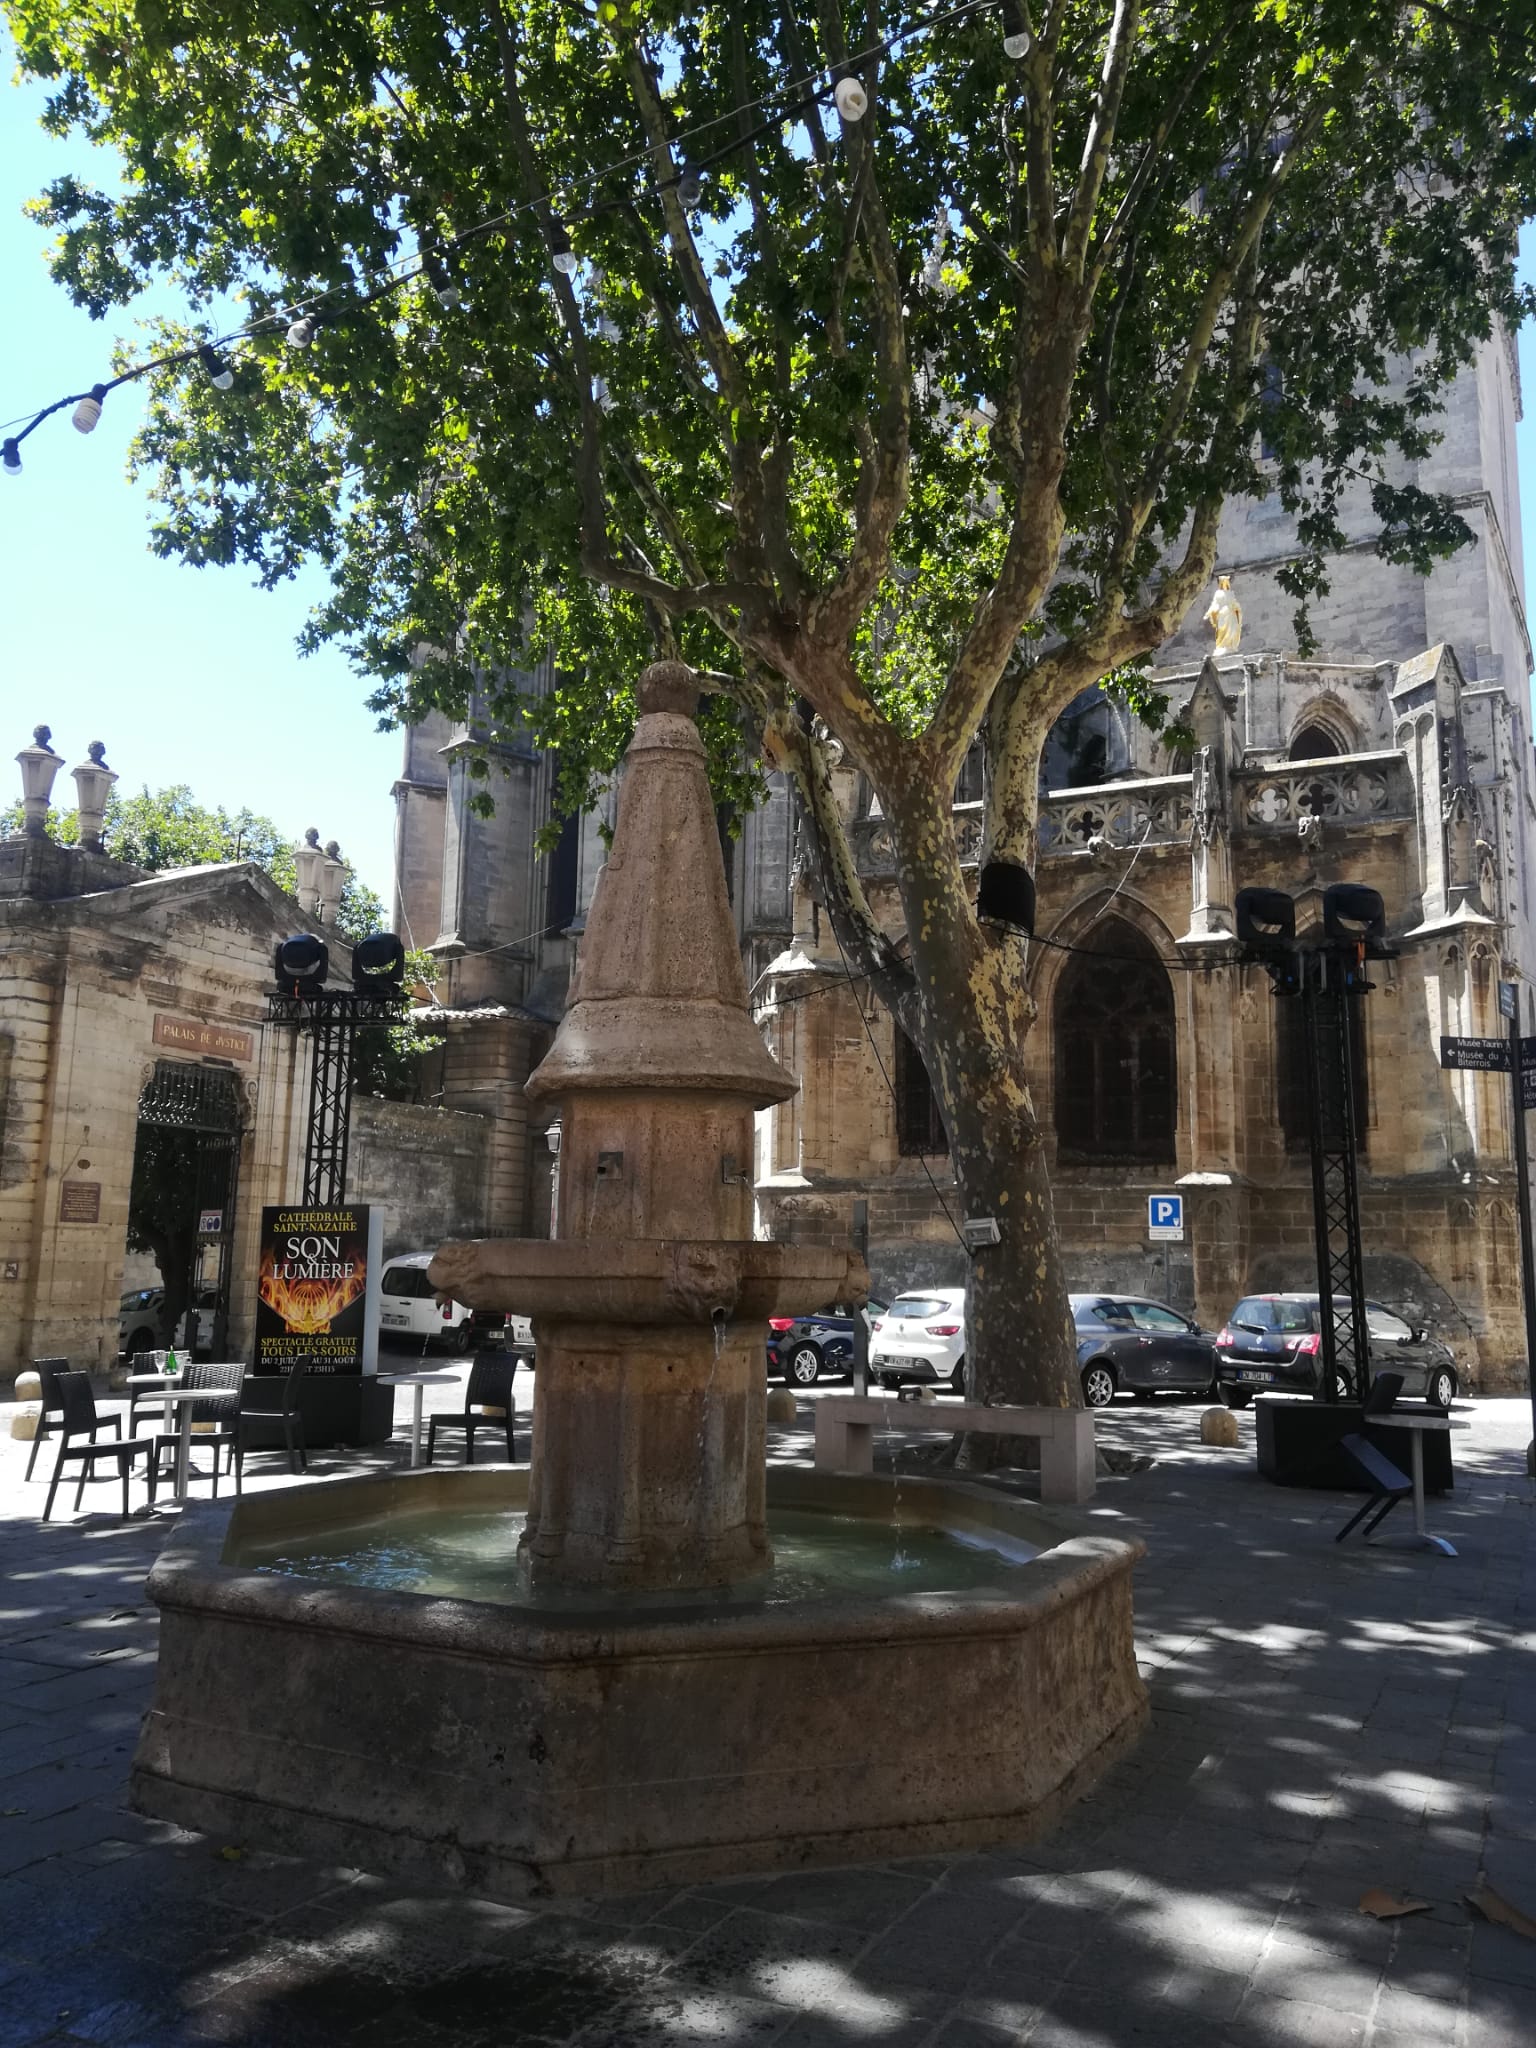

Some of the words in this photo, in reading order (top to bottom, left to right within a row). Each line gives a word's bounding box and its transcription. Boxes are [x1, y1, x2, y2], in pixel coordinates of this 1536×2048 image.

[163, 1025, 195, 1040] PALAIS
[201, 1032, 210, 1044] DE
[1457, 1039, 1480, 1048] Musée
[1482, 1040, 1503, 1048] Taurin
[1458, 1050, 1484, 1060] Musée
[1488, 1051, 1499, 1060] du
[1458, 1058, 1491, 1067] Biterrois
[279, 1210, 353, 1222] CATHÉDRALE
[1158, 1202, 1173, 1222] P
[273, 1222, 357, 1232] SAINT-NAZAIRE
[286, 1236, 341, 1259] SON
[307, 1253, 318, 1265] &
[273, 1260, 354, 1279] LUMIÈRE
[261, 1337, 314, 1346] SPECTACLE
[315, 1337, 357, 1346] GRATUIT
[261, 1347, 293, 1356] TOUS
[296, 1346, 317, 1355] LES
[320, 1346, 357, 1356] SOIRS
[261, 1357, 273, 1365] DU
